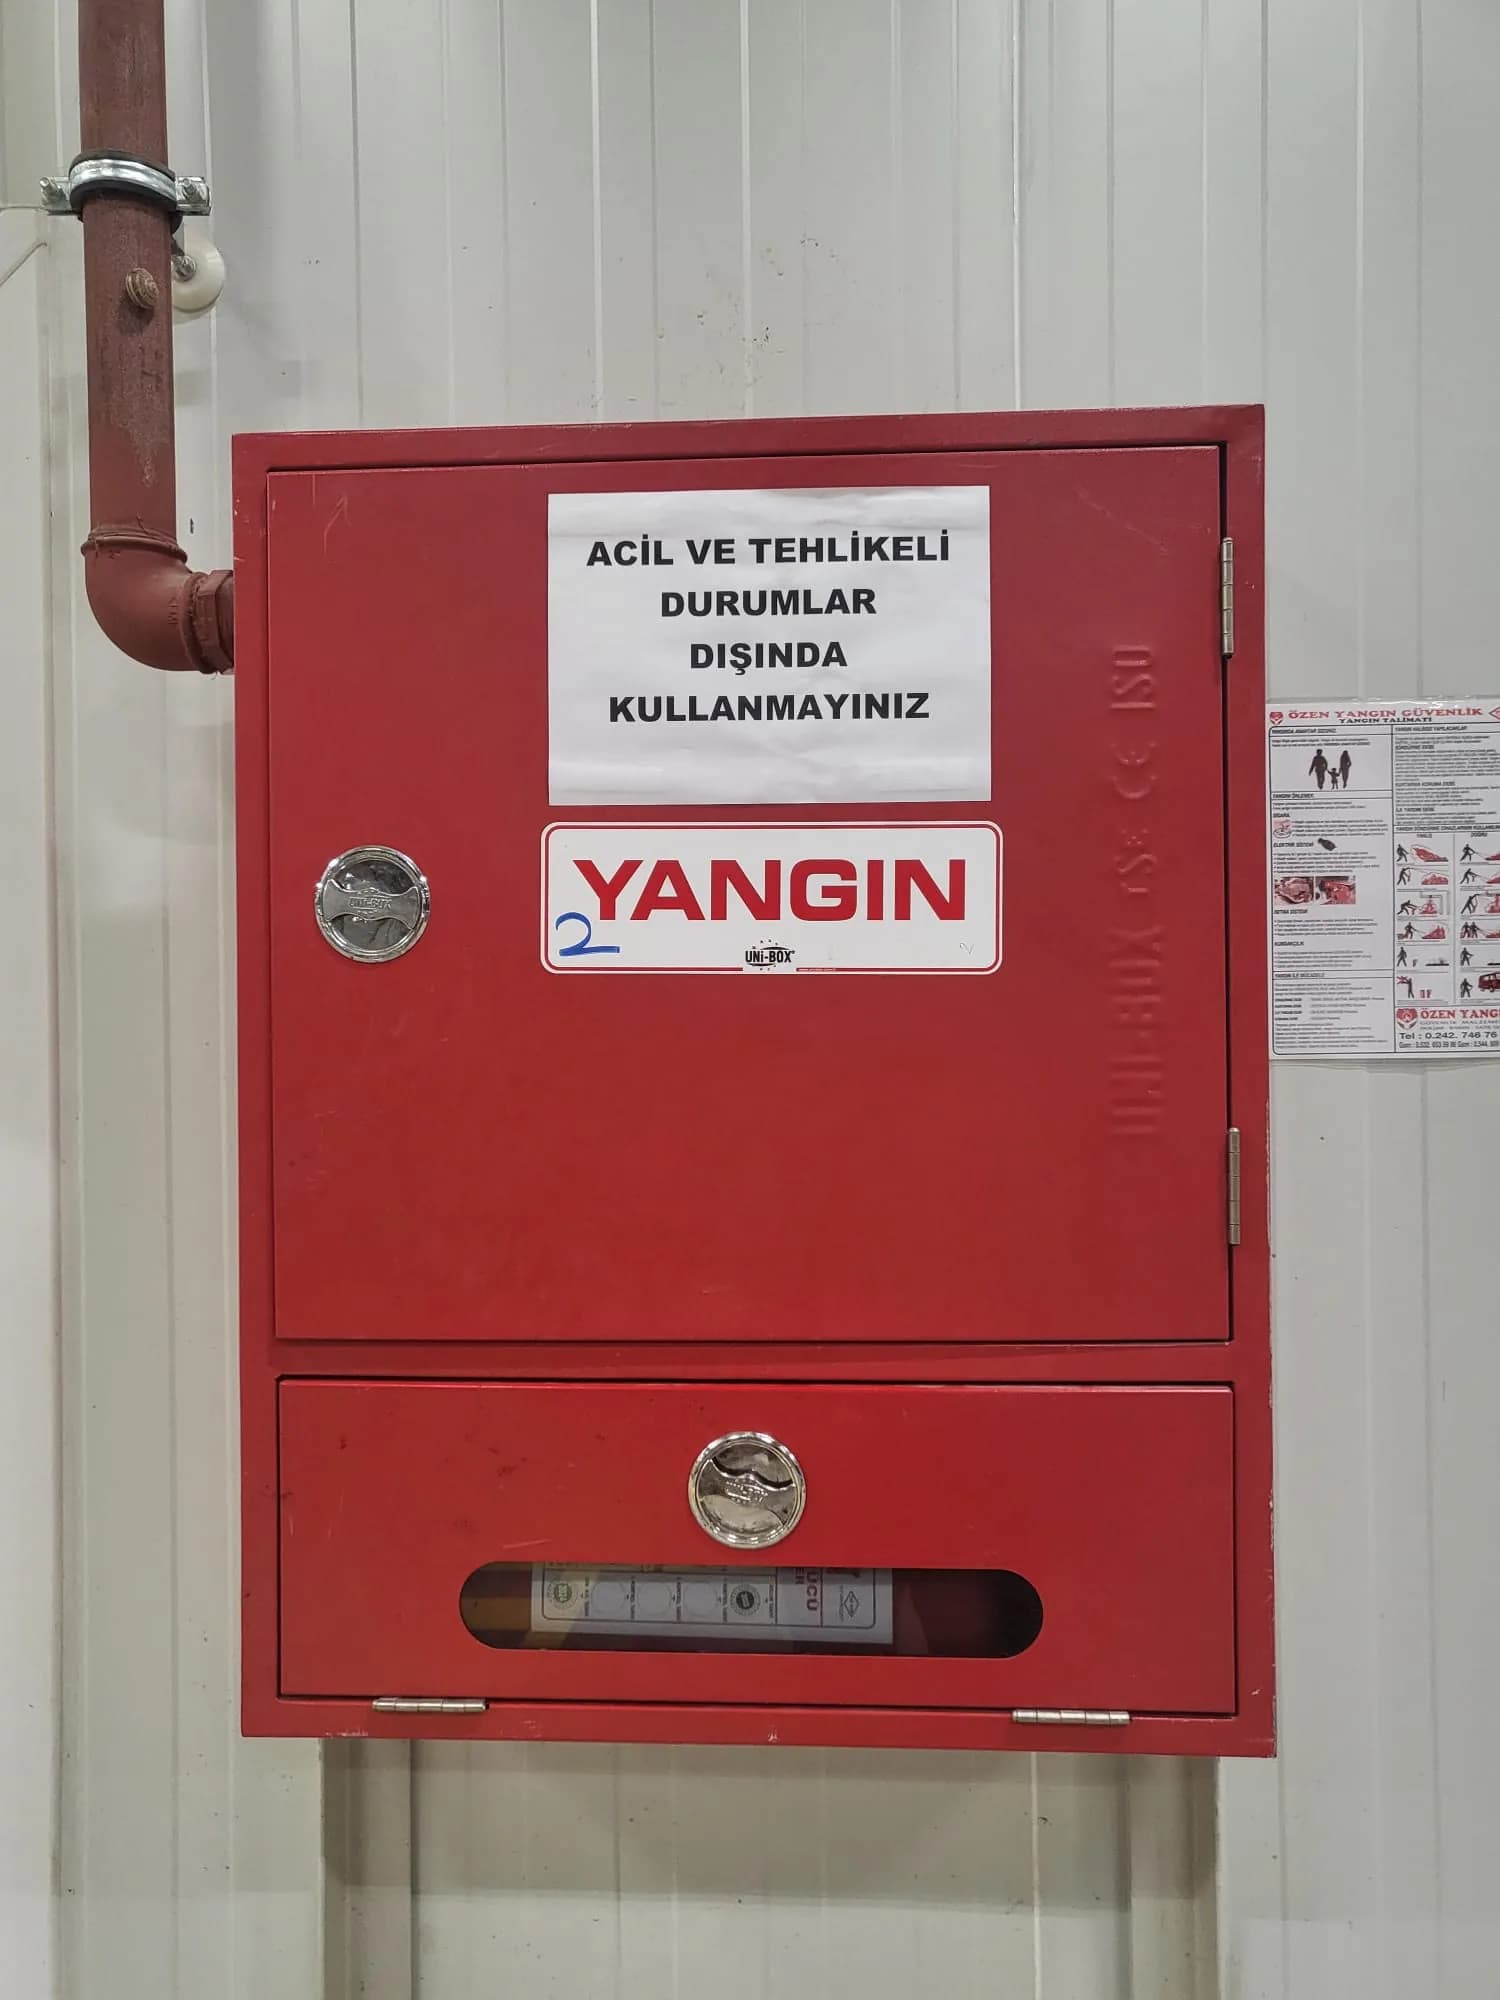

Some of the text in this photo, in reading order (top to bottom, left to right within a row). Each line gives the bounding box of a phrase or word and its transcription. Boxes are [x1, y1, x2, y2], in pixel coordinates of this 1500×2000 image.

[586, 529, 950, 567] ACİL VE TEHLİKELİ
[661, 588, 877, 618] DURUMLAR
[690, 641, 848, 676] DIŞINDA
[1109, 642, 1156, 712] ISO
[609, 692, 930, 723] KULLANMAYINIZ
[1288, 707, 1483, 719] ÖZEN YANGIN GÜVENLİK
[573, 860, 966, 921] YANGIN
[555, 912, 620, 957] 2
[1421, 1008, 1500, 1019] ÖZEN YANG
